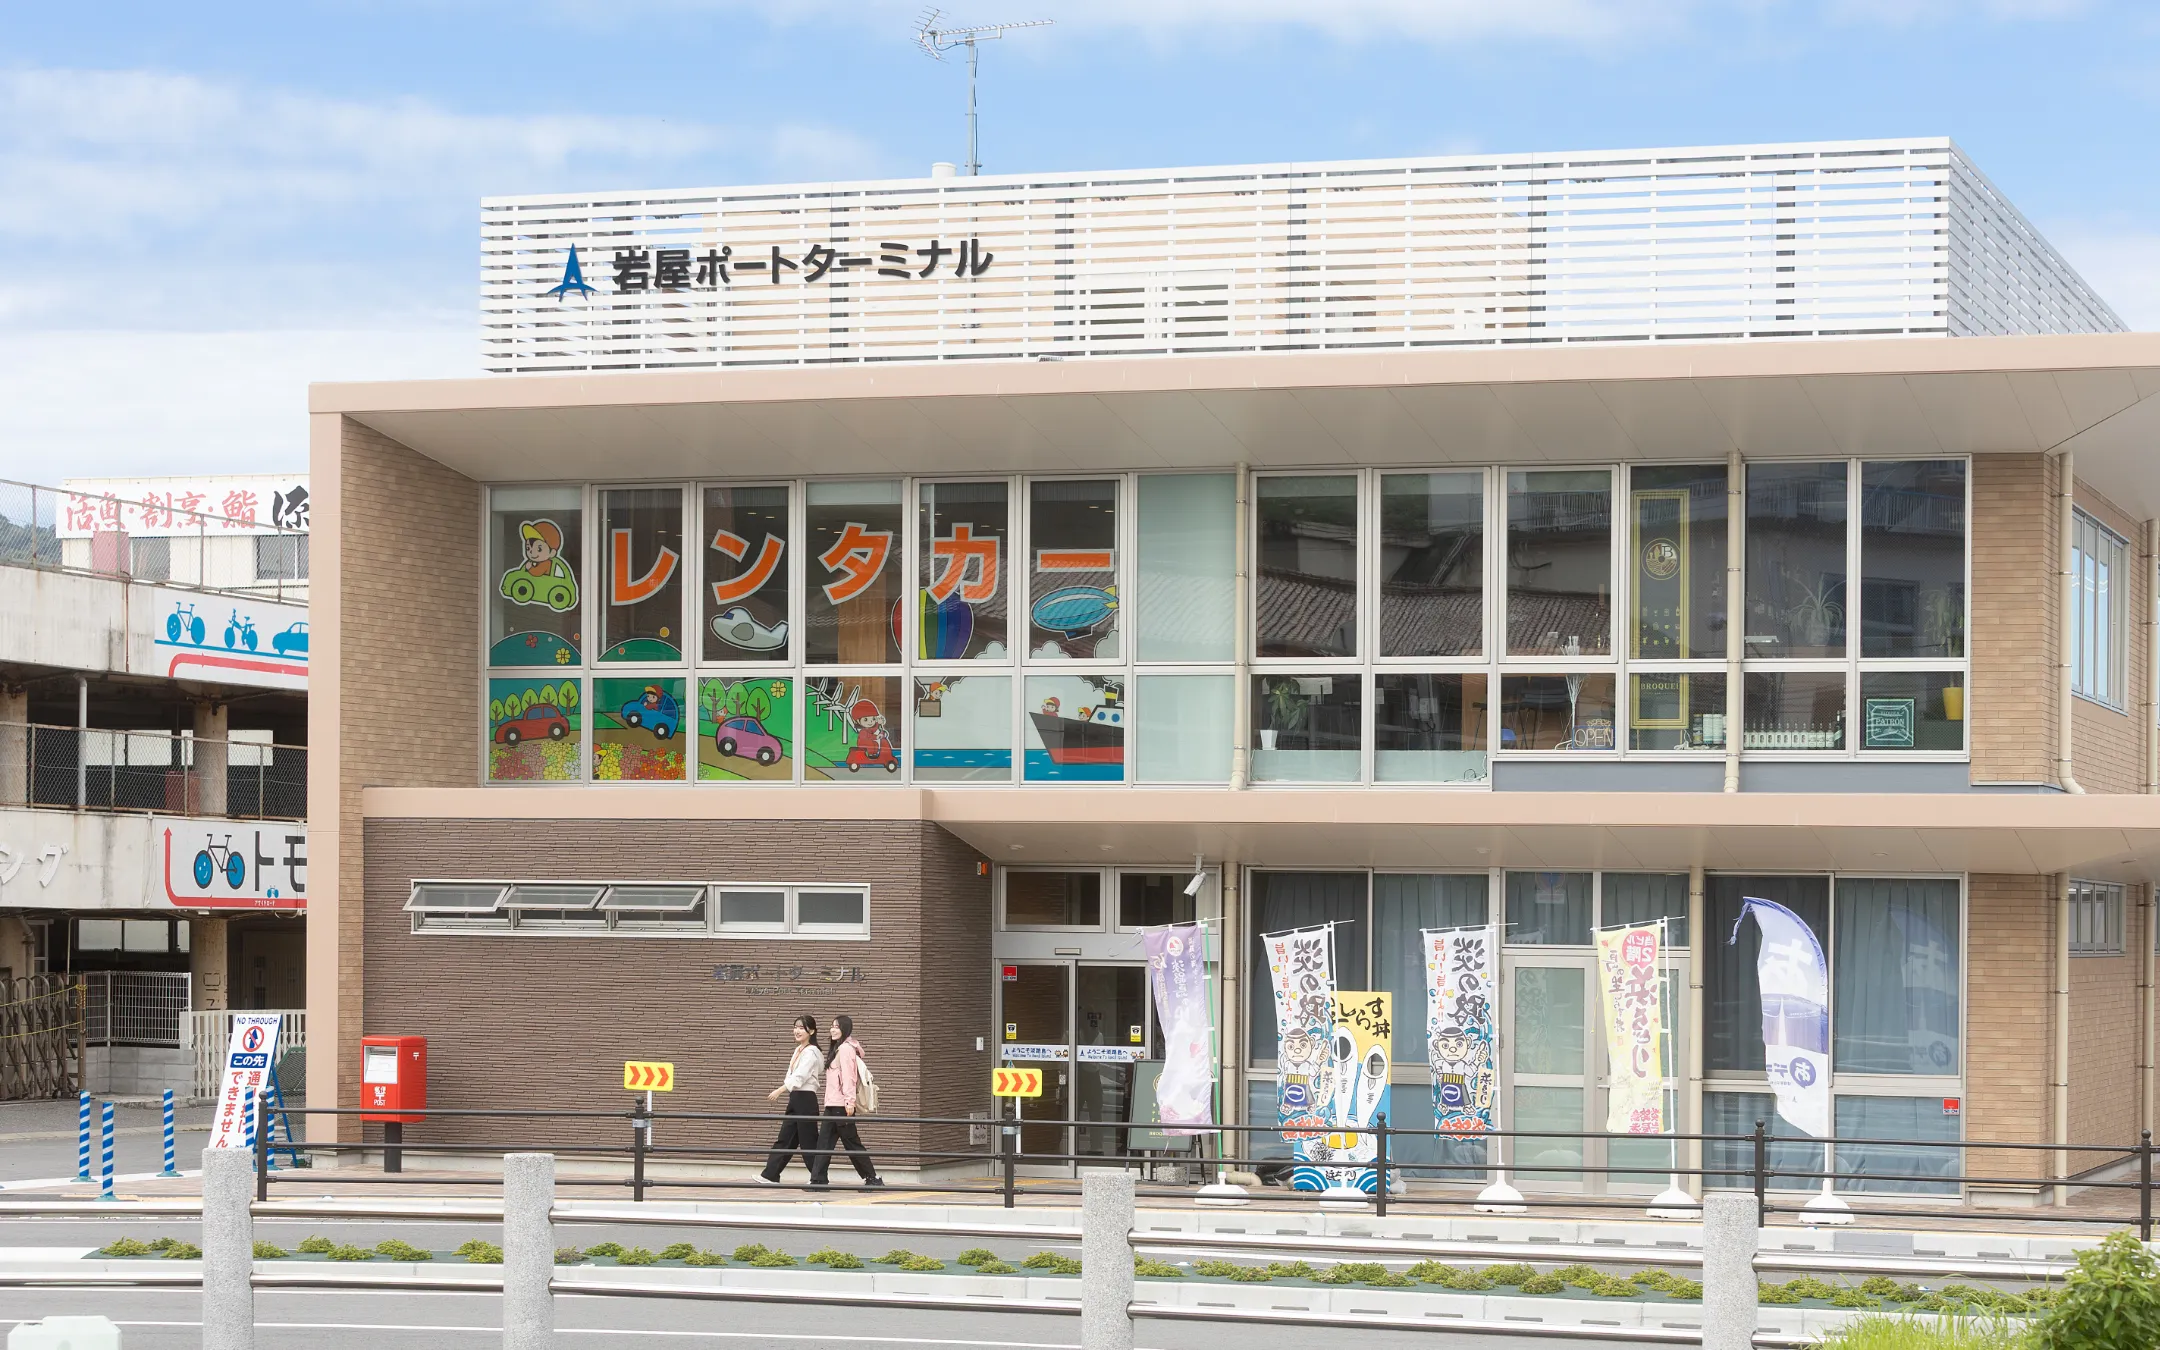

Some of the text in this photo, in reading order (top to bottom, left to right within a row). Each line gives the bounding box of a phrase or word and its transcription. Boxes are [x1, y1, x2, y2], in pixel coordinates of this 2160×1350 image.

[613, 238, 994, 291] 岩屋ポートターミナル
[611, 521, 1115, 606] レンタカー
[1575, 728, 1613, 746] OPEN
[236, 1017, 278, 1025] NO THROUGH
[233, 1055, 265, 1067] この先
[215, 1071, 243, 1148] できません
